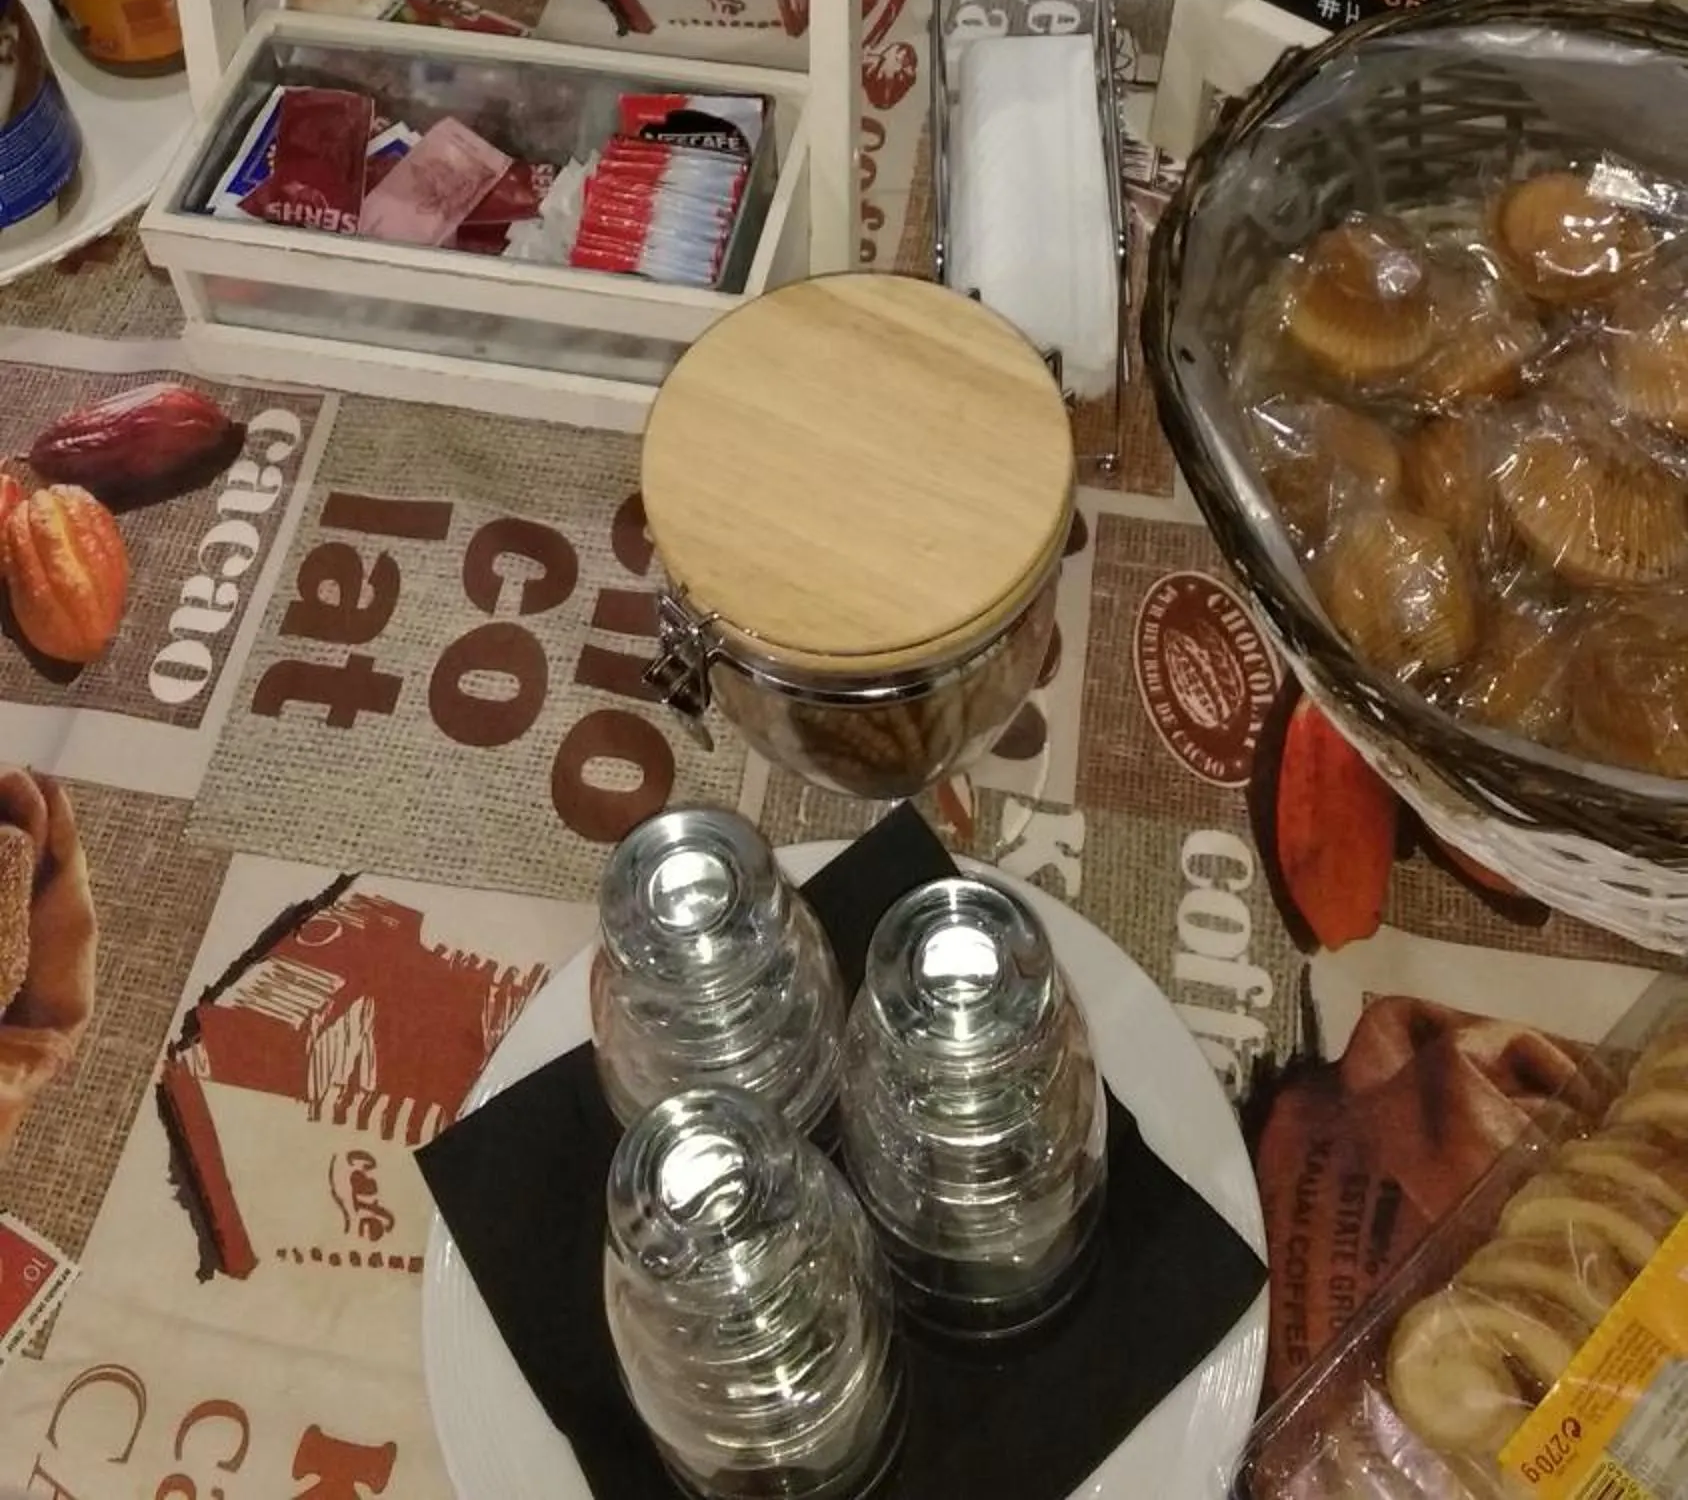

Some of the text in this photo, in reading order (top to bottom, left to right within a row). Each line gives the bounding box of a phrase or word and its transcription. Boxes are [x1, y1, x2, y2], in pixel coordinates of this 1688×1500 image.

[149, 407, 300, 703] cacao
[251, 491, 454, 729] lat
[427, 517, 579, 748] co
